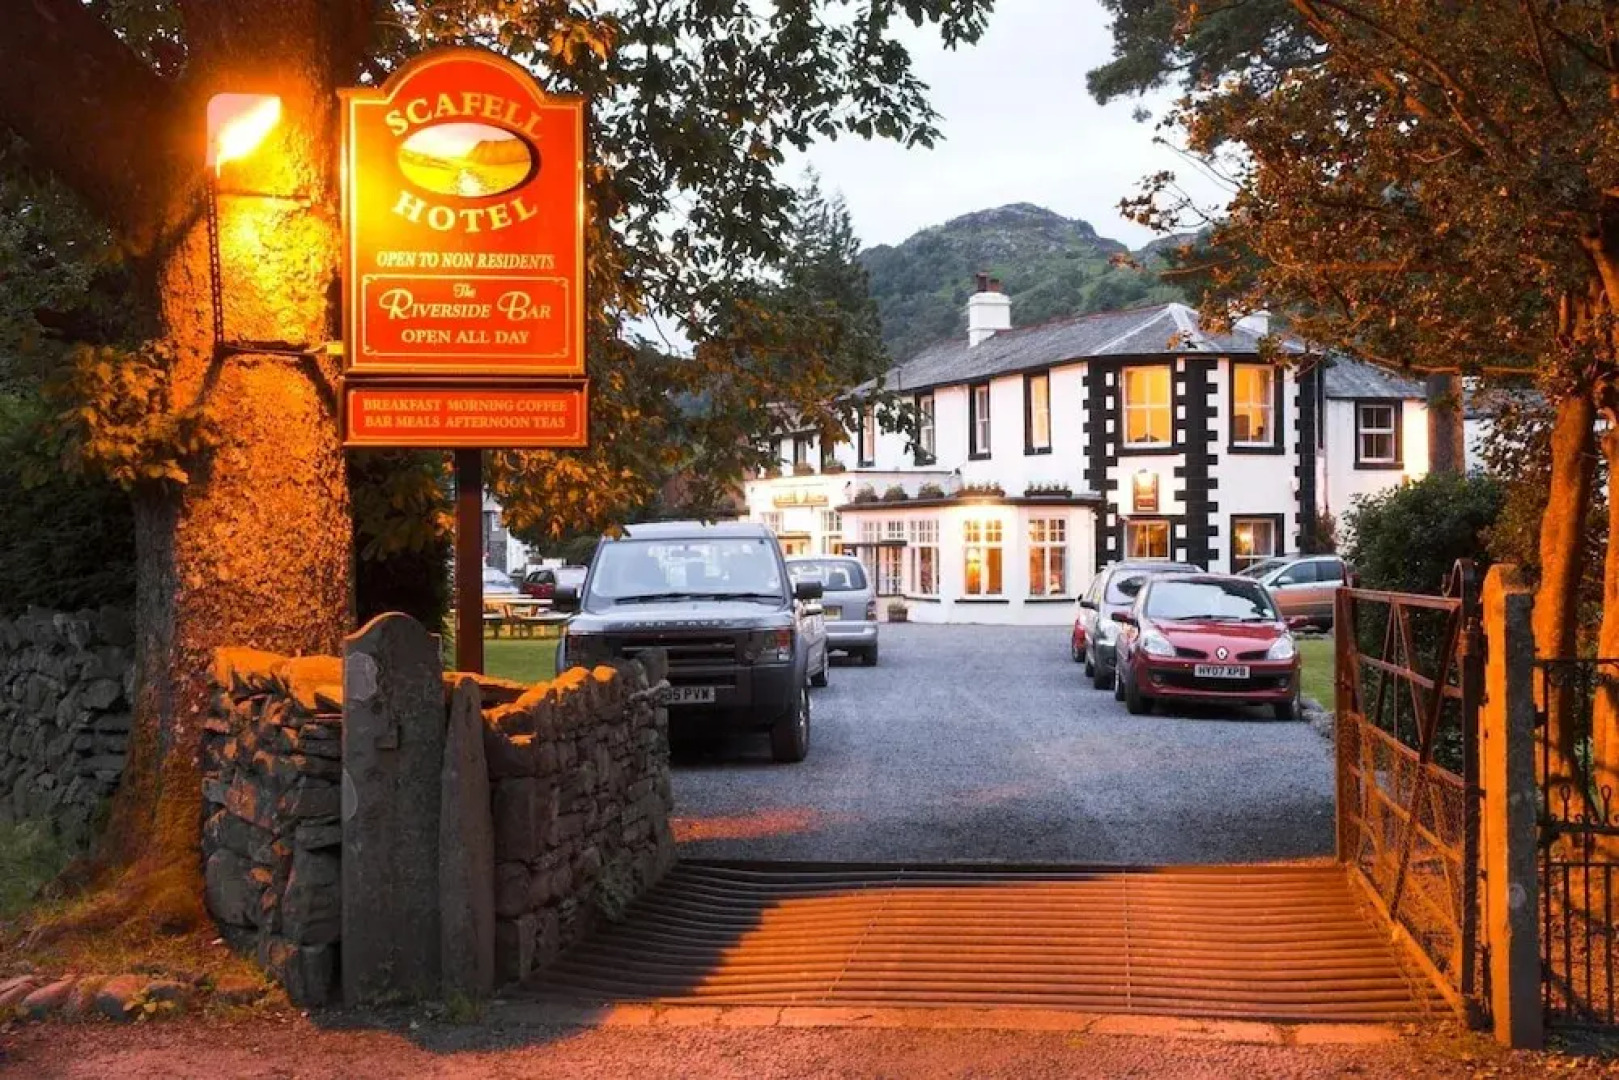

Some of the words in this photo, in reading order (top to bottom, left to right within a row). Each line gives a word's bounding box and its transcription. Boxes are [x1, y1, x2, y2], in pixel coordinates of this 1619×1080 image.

[385, 91, 545, 139] SCAFELL
[391, 190, 538, 233] HOTEL
[376, 252, 417, 268] OPEN
[419, 253, 439, 268] TO
[441, 253, 474, 269] NON
[476, 254, 555, 270] RESIDENTS
[453, 283, 476, 298] The
[379, 288, 492, 320] RIVERSIDE
[497, 291, 551, 321] BAR
[401, 330, 451, 344] OPEN
[456, 330, 490, 344] ALL
[495, 331, 529, 344] DAY
[362, 398, 441, 411] BREAKFAST
[447, 399, 514, 412] MORNING
[516, 399, 567, 412] COFFEE
[365, 415, 393, 428] BAR
[395, 415, 441, 428] MEALS
[445, 415, 530, 428] AFTERNOON
[531, 415, 565, 428] TEAS
[1198, 666, 1224, 676] HY07
